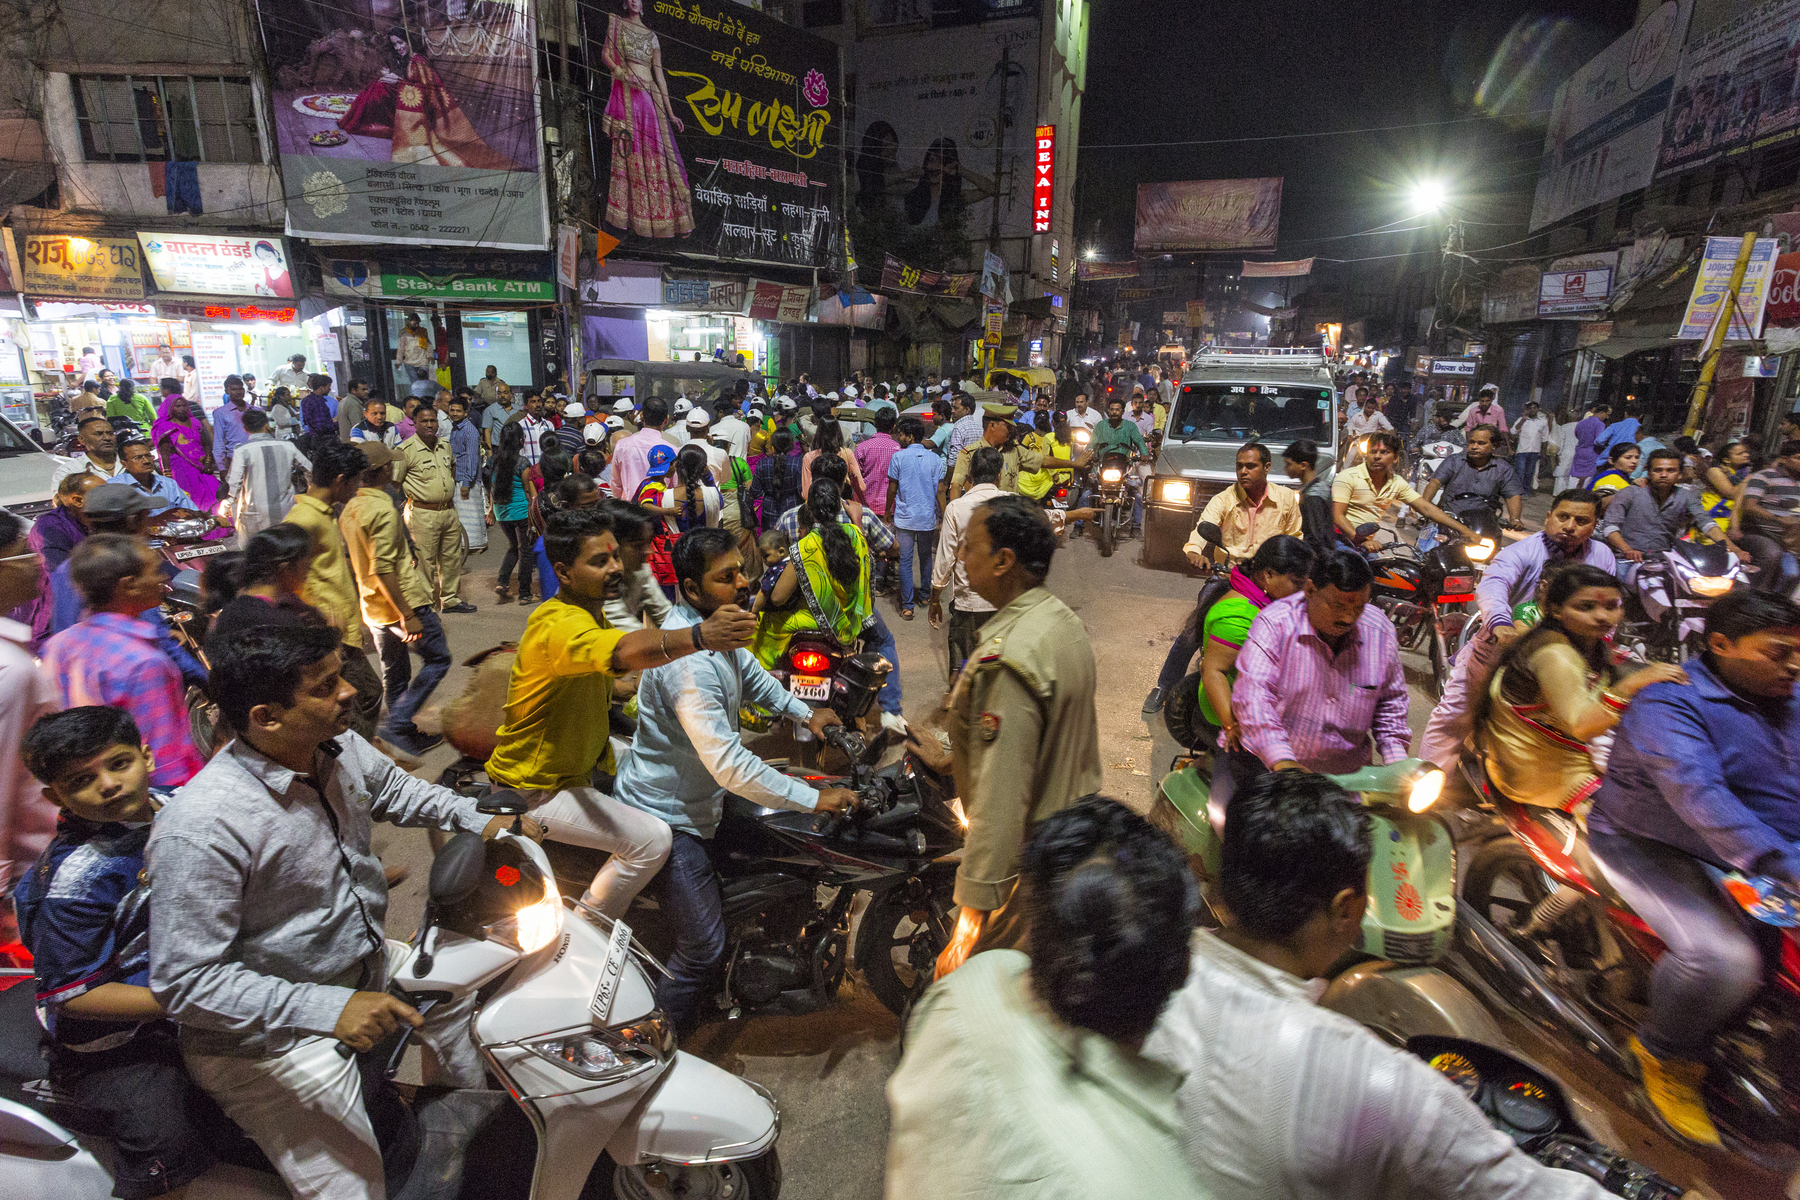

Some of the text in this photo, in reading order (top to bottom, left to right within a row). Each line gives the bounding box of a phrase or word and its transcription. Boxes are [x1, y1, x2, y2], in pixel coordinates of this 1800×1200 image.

[653, 0, 761, 46] आपके सौन्दर्य को दें हम
[995, 28, 1039, 44] CLINIC
[711, 47, 797, 86] नई परिभाषा
[667, 69, 832, 159] रूप लक्ष्मी
[1036, 126, 1054, 137] HOTEL
[1036, 139, 1052, 231] DEVA INN
[695, 183, 732, 207] वैवाहिक
[734, 191, 768, 213] साड़ियाँ
[371, 221, 388, 230] फोन
[410, 224, 429, 232] 0542
[439, 226, 470, 234] 2222271
[723, 222, 777, 247] सलवार-सूट
[109, 244, 138, 272] घर
[164, 239, 253, 259] बादल ठंडई
[396, 278, 541, 293] State Bank ATM
[786, 287, 805, 303] शिवा
[752, 293, 782, 309] Coca-Cola
[1434, 363, 1475, 372] मिल्क शेक
[1231, 386, 1278, 395] जय हिन्द
[793, 686, 826, 698] 8460
[553, 933, 571, 964] HONDA
[594, 983, 611, 1014] UP65
[616, 927, 629, 950] 1666
